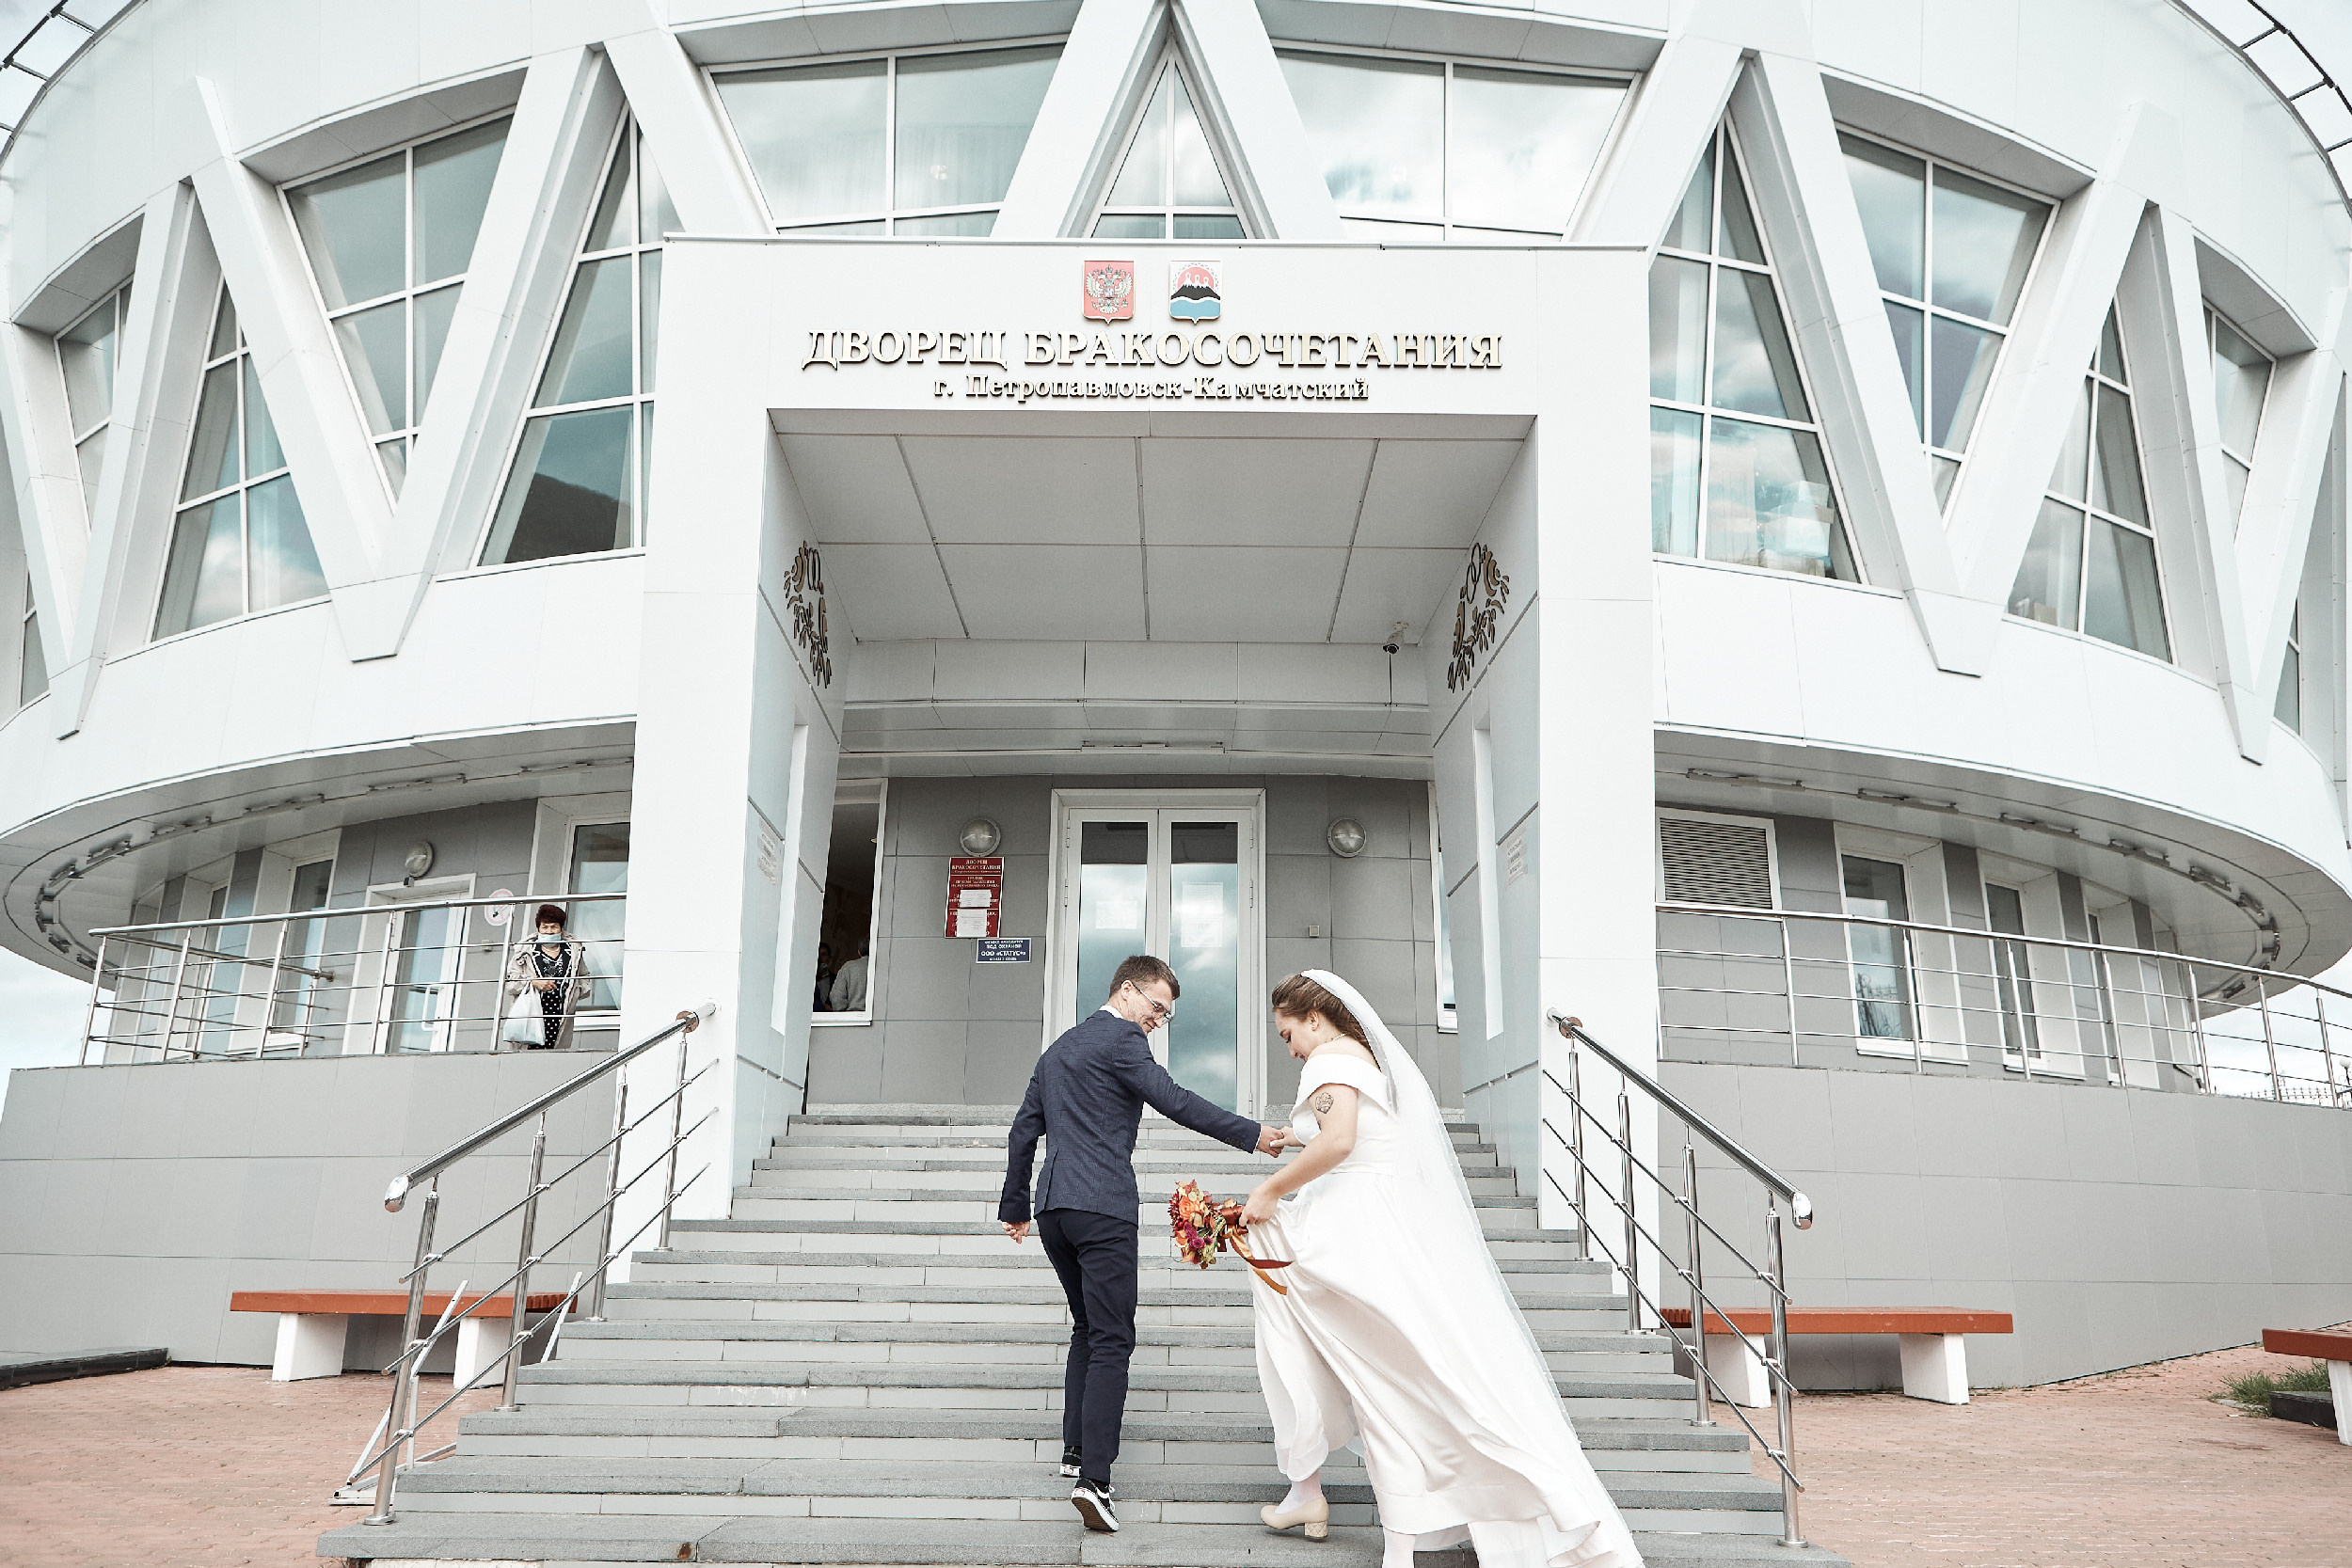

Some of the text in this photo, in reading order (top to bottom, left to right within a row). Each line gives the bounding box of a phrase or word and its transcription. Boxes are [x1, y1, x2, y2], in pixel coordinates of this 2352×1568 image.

[802, 329, 1502, 371] ДВОРЕЦ БРАКОСОЧЕТАНИЯ
[934, 374, 1369, 404] г. Петропавловск-Камчатский
